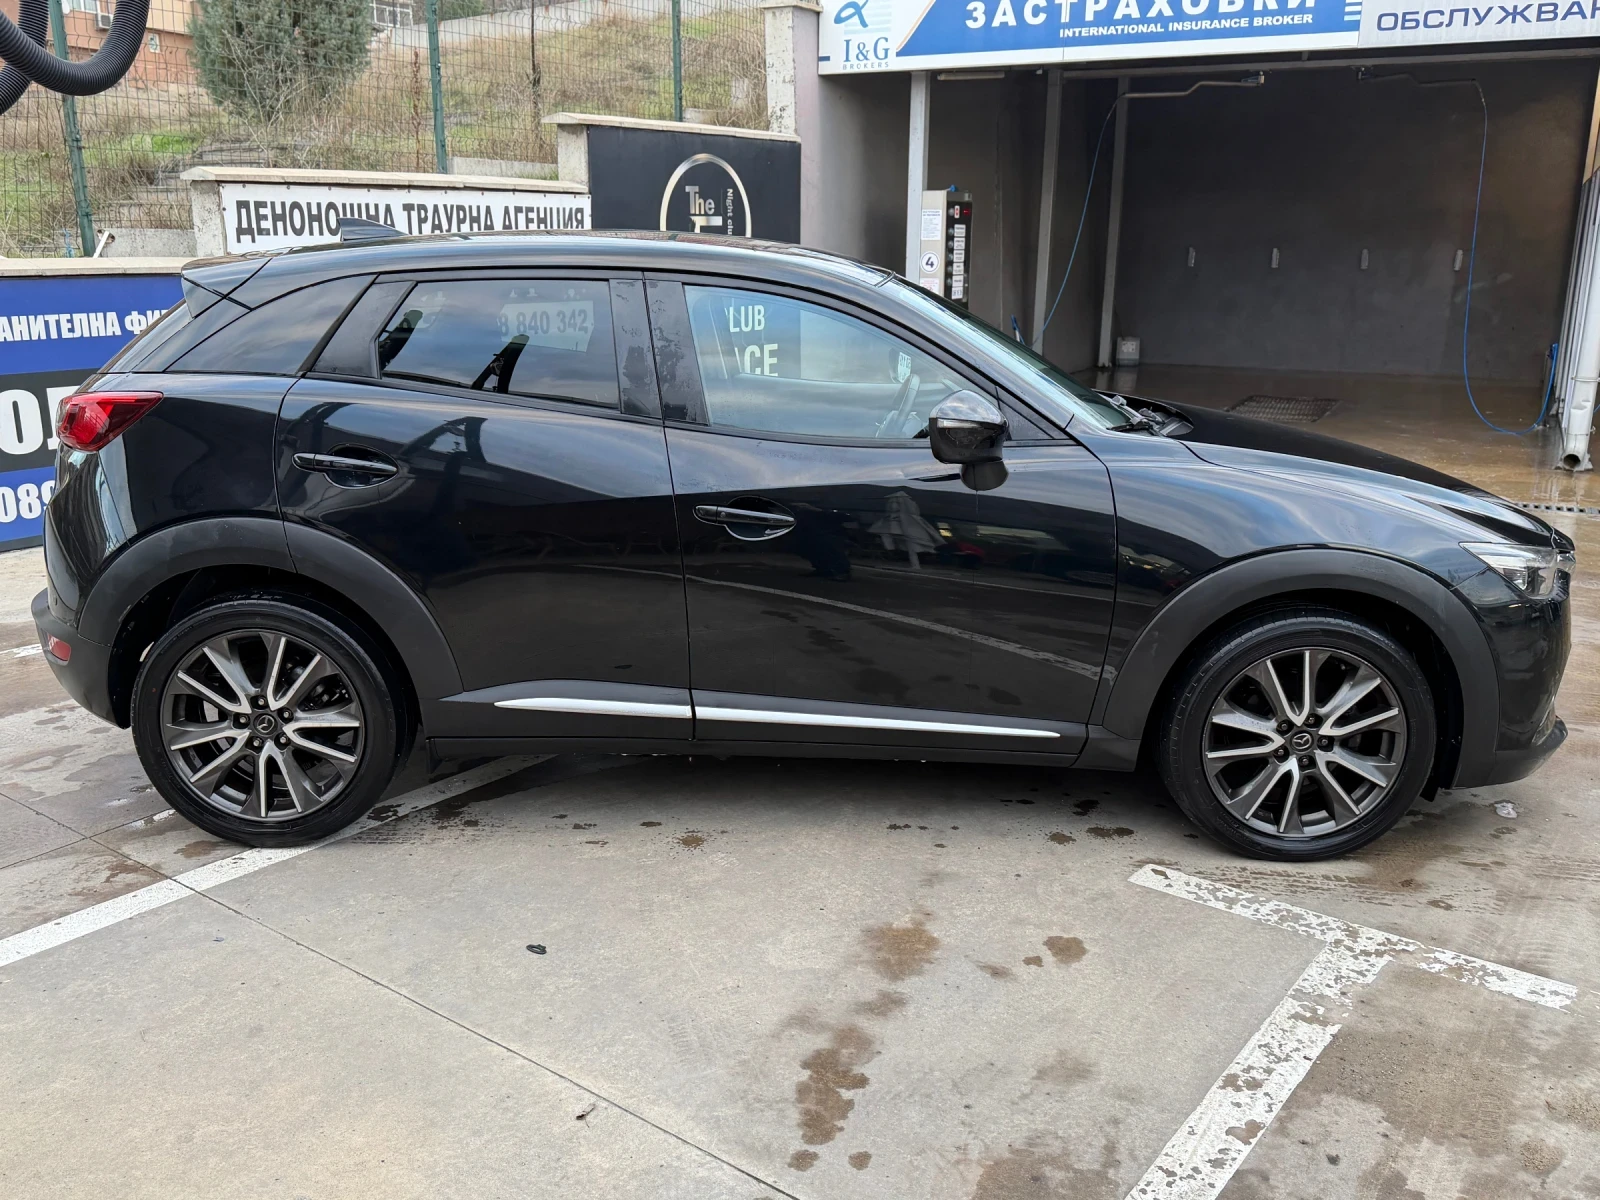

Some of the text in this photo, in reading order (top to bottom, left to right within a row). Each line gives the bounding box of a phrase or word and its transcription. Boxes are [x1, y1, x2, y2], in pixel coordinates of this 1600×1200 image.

[1059, 14, 1313, 38] INTERNATIONAL INSURANCE BROKER
[842, 61, 890, 70] BROKERS
[685, 185, 715, 215] The
[725, 188, 734, 217] Night
[402, 203, 495, 235] ТРАУРНА
[502, 206, 584, 230] АГЕНЦИЯ
[925, 256, 935, 268] 4
[124, 309, 169, 335] ФИ
[516, 310, 550, 335] 840
[556, 308, 589, 335] 342
[725, 304, 765, 333] LUB
[735, 343, 778, 377] CE
